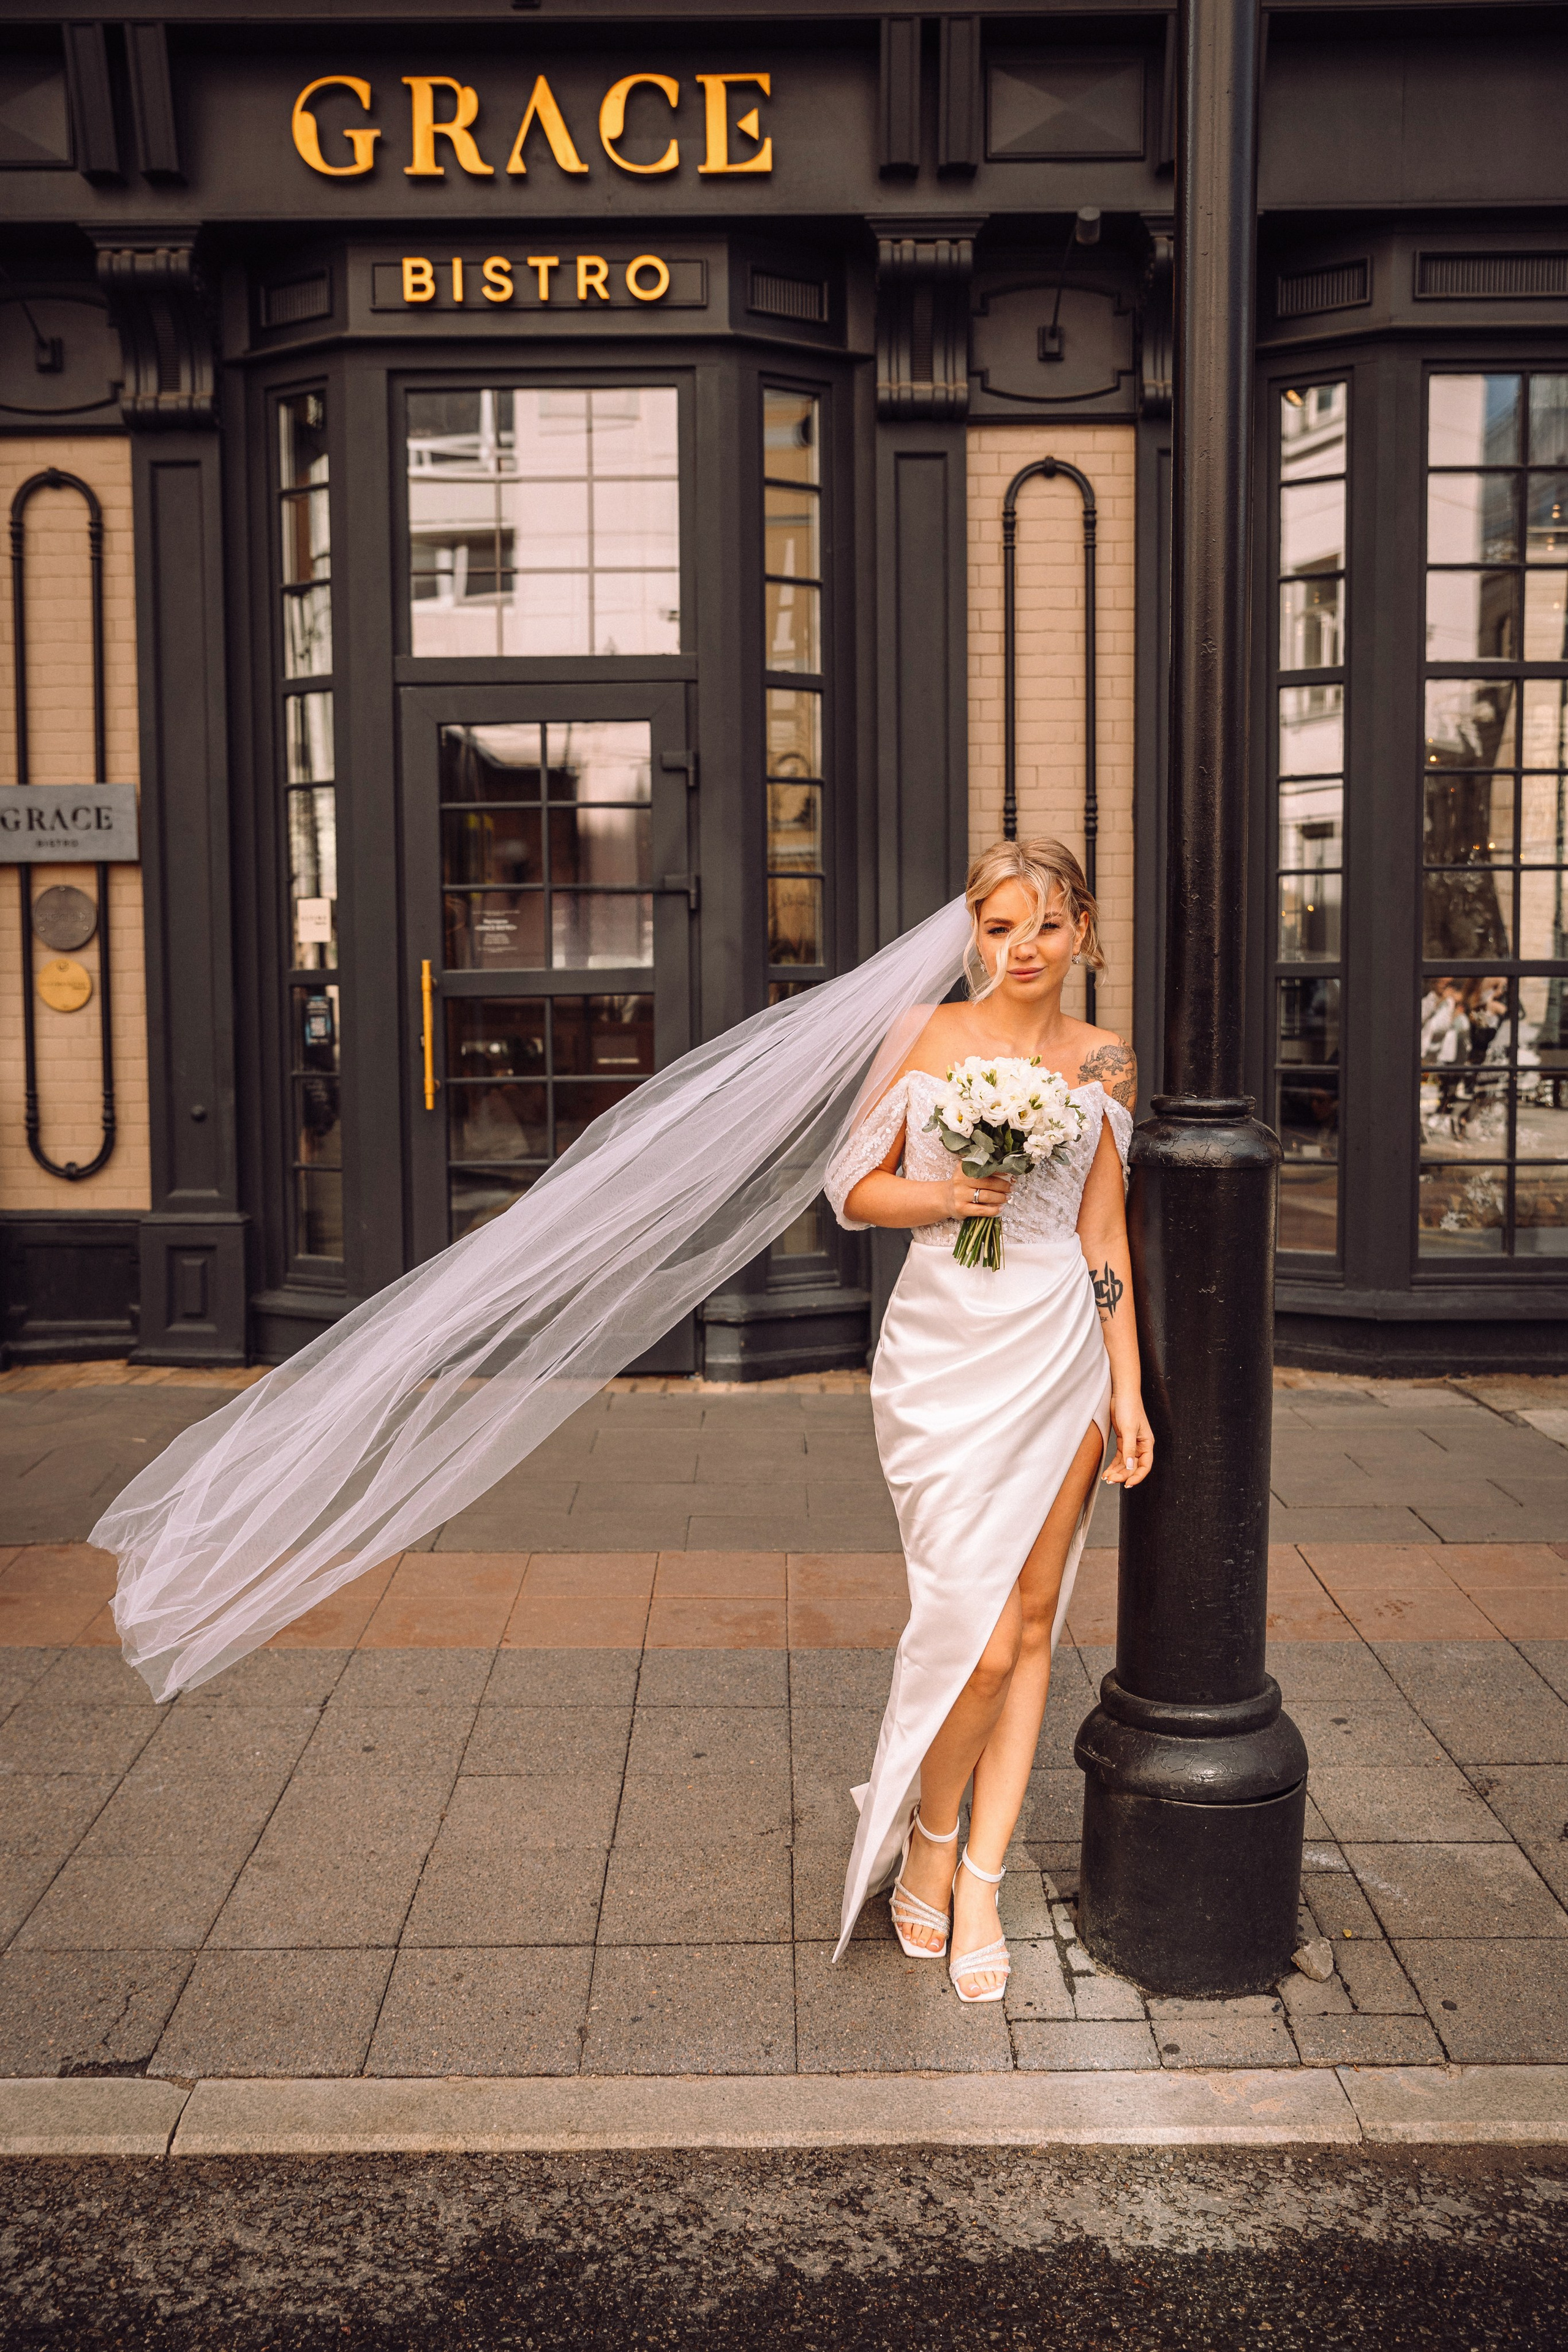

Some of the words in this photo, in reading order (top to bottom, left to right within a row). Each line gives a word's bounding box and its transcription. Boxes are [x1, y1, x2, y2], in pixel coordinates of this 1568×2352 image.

[292, 72, 772, 176] GRACE
[402, 254, 669, 302] BISTRO
[0, 805, 113, 832] GRACE
